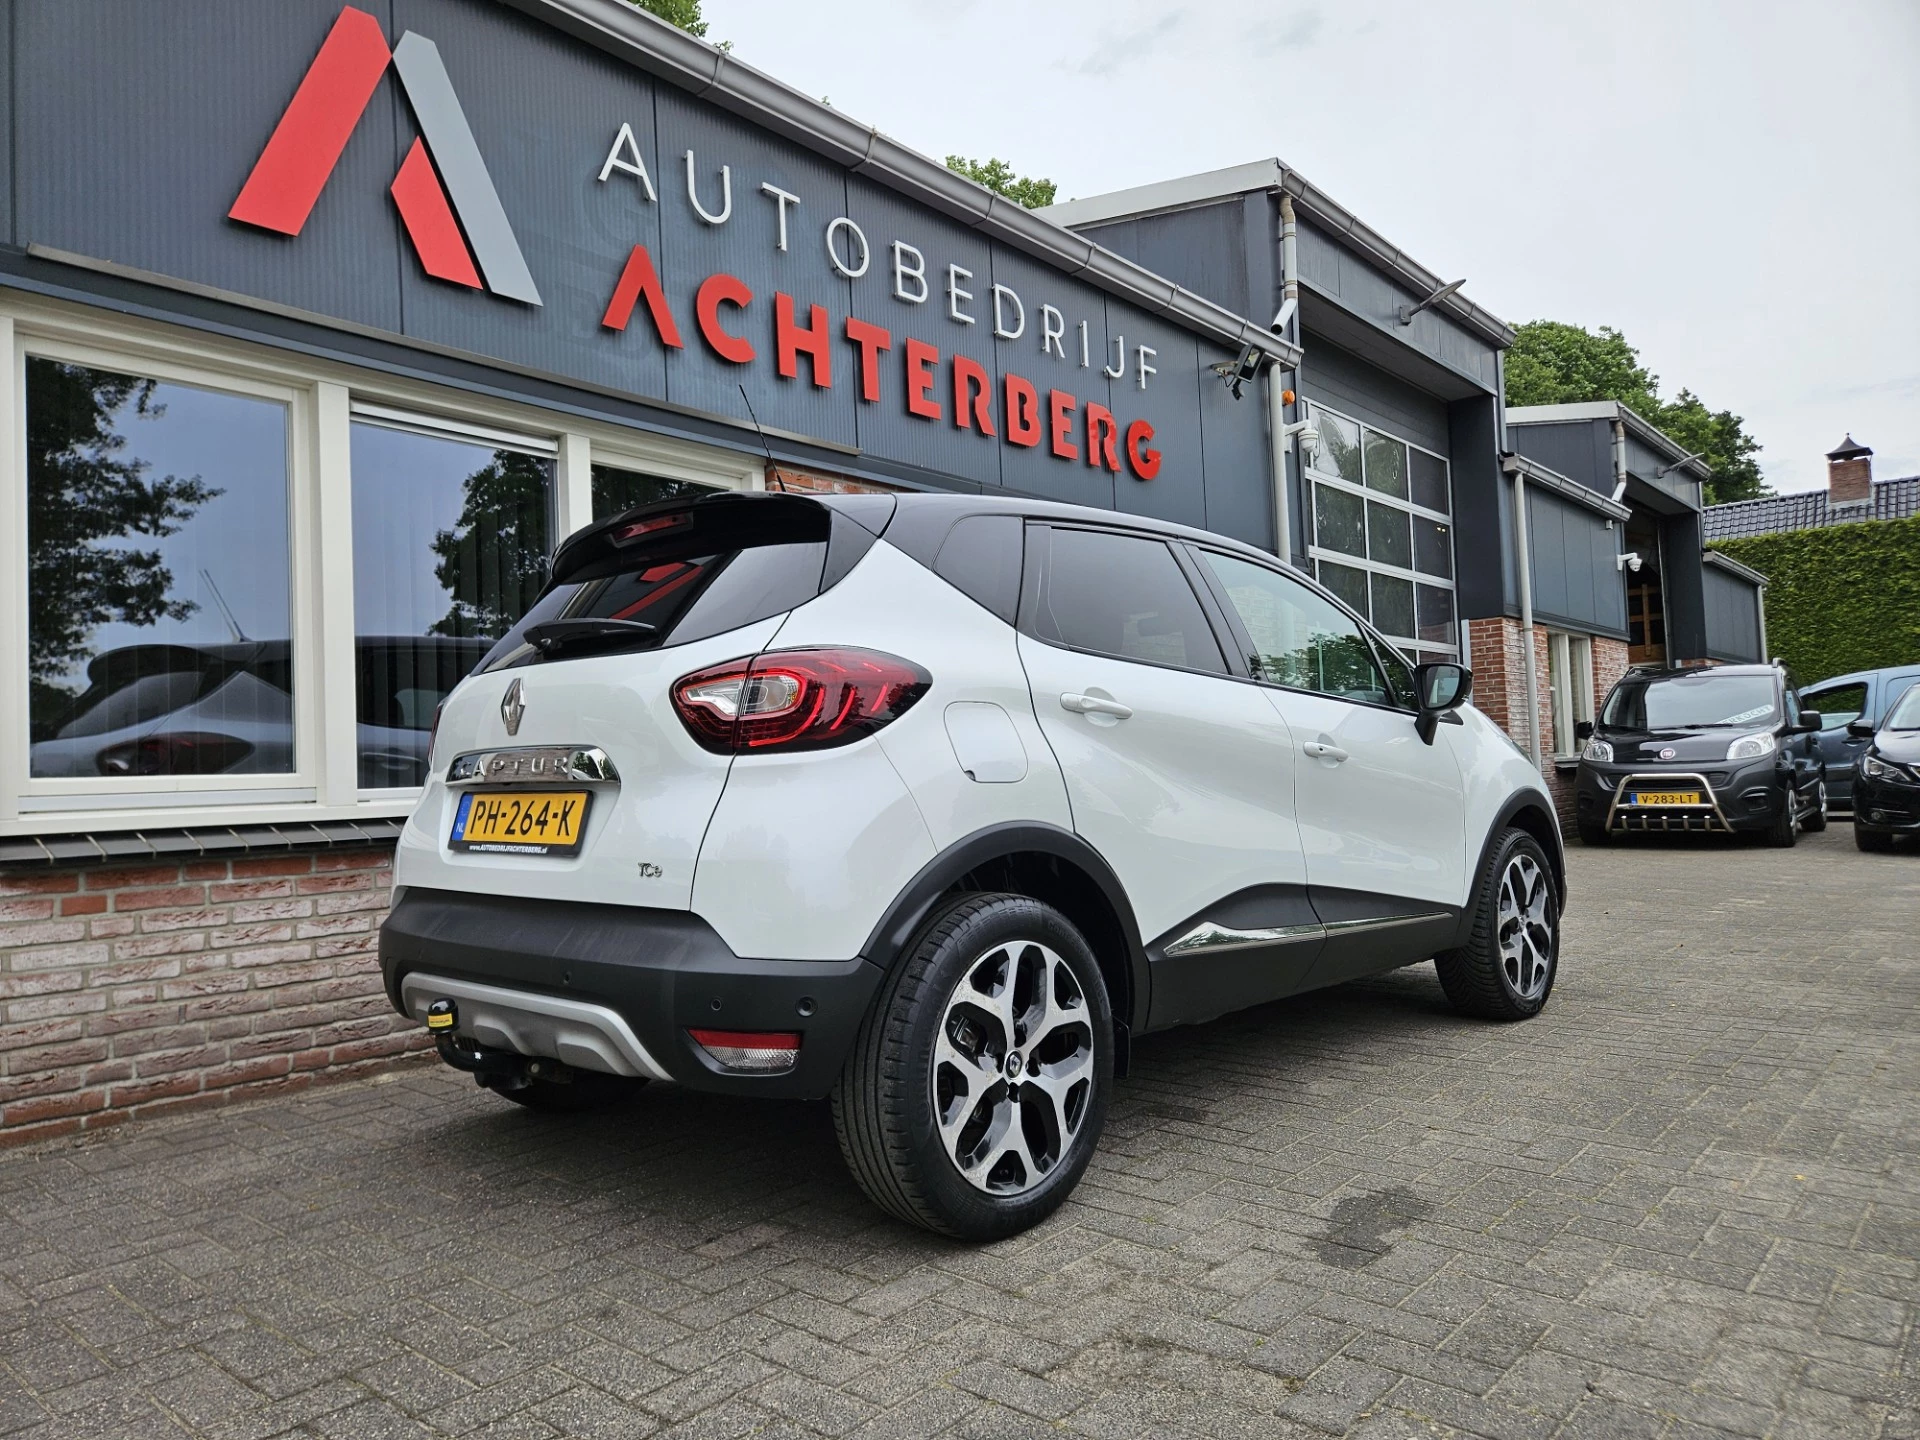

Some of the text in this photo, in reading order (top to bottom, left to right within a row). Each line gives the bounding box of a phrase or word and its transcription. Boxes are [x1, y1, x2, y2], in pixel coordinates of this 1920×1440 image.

[598, 122, 1158, 390] AUTOBEDRIJF
[602, 244, 1162, 481] ACHTERBERG
[460, 756, 569, 776] CAPTUR
[1641, 794, 1693, 804] V-283-LT
[456, 822, 464, 833] NL
[469, 800, 576, 837] PH-264-K
[638, 862, 662, 877] TCe
